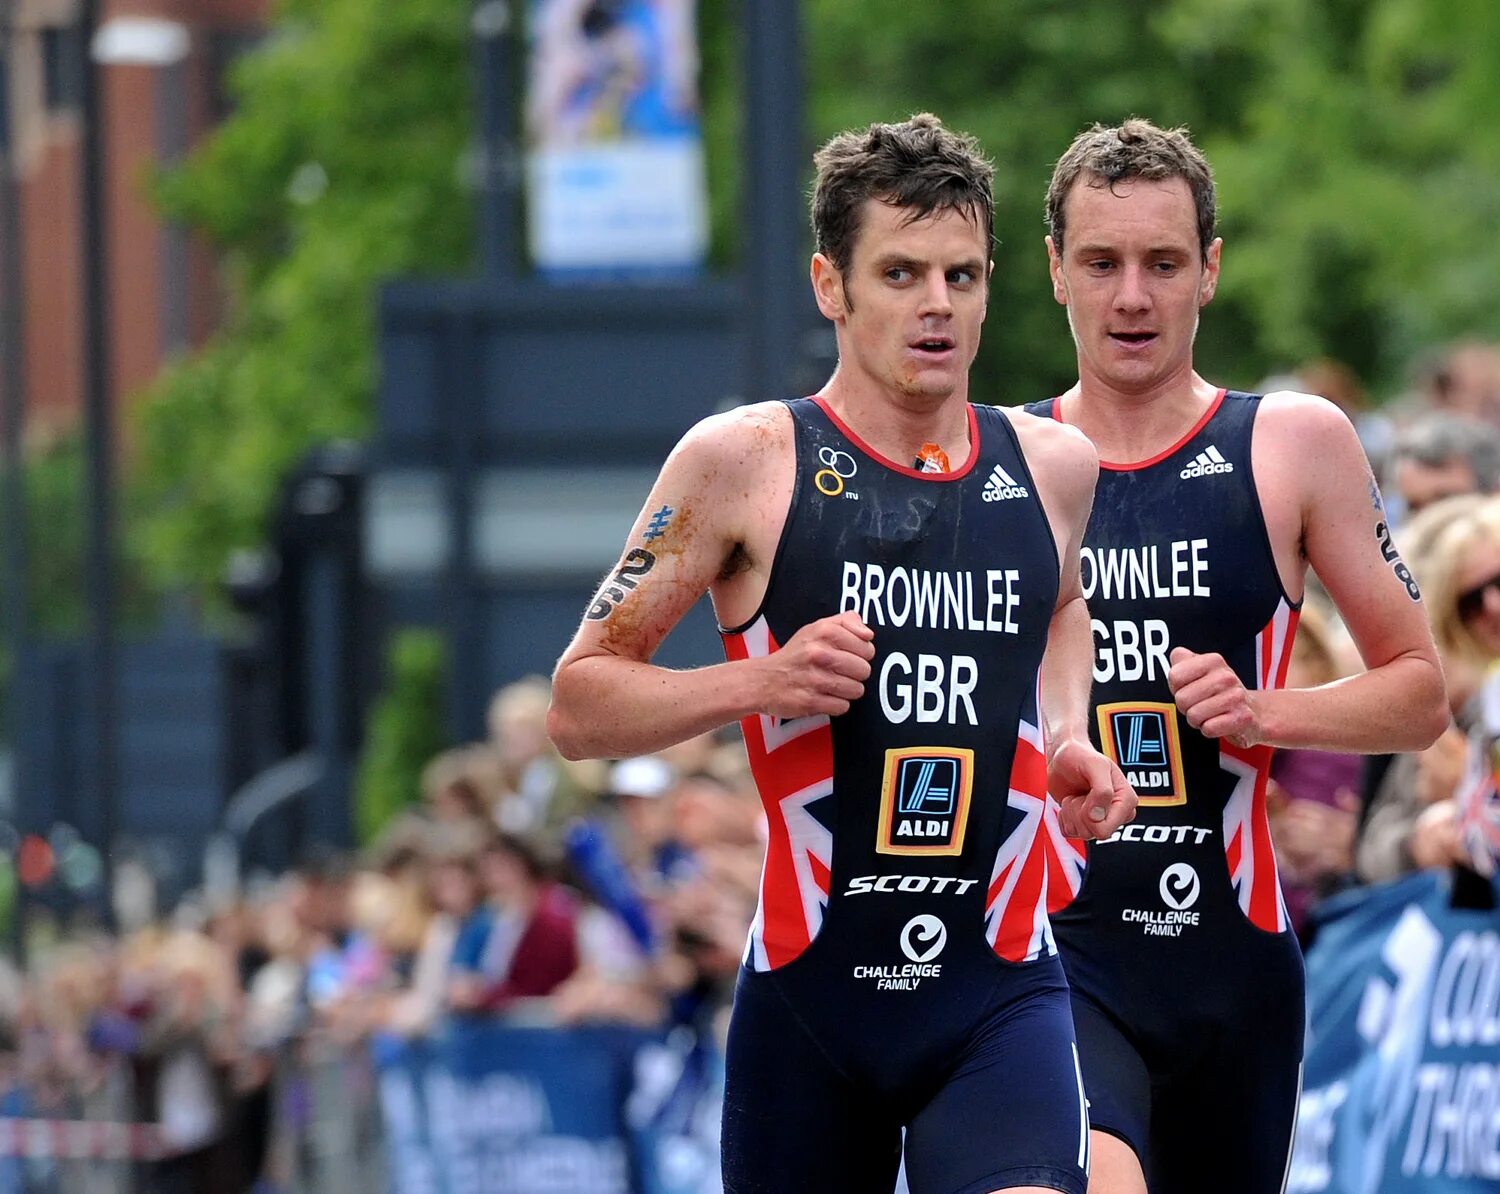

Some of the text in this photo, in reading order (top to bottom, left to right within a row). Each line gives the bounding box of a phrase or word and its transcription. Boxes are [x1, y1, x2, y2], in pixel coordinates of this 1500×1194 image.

[1180, 461, 1234, 480] adidas
[981, 485, 1029, 503] adidas
[1080, 538, 1211, 601] OWNLEE
[1375, 521, 1421, 601] 28
[840, 561, 1021, 634] BROWNLEE
[1090, 618, 1171, 684] GBR
[879, 652, 979, 726] GBR
[1126, 771, 1170, 788] ALDI
[897, 820, 949, 837] ALDI
[1096, 824, 1213, 845] SCOTT
[844, 875, 979, 896] SCOTT
[1122, 908, 1200, 926] CHALLENGE
[1143, 923, 1183, 937] FAMILY
[853, 964, 942, 979] CHALLENGE
[877, 978, 920, 991] FAMILY
